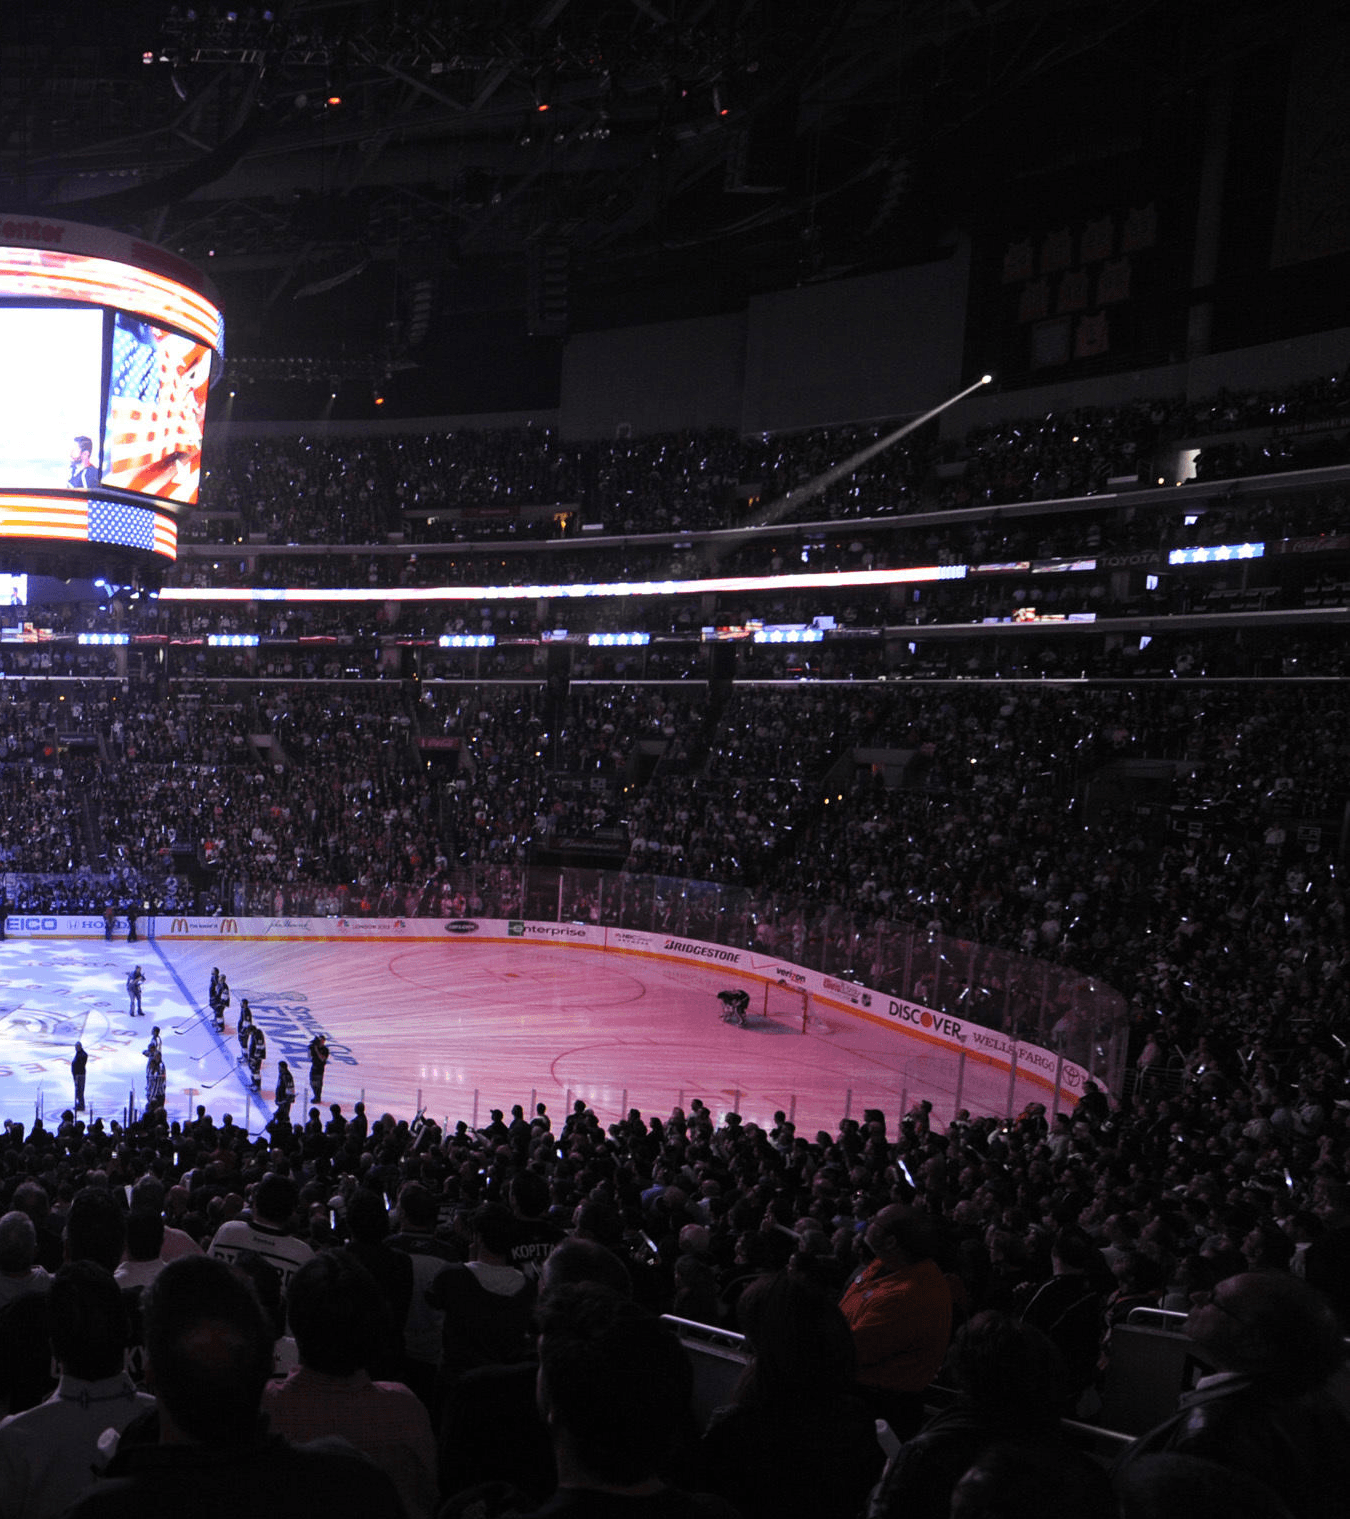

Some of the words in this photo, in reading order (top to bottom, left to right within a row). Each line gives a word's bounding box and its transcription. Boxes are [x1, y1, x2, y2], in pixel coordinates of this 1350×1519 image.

[1098, 552, 1160, 567] TOYOTA
[513, 922, 587, 937] enterprise
[663, 939, 742, 963] BRIDGESTONE
[776, 967, 806, 984] verizon
[889, 1001, 962, 1040] DISCOVER
[973, 1032, 1016, 1055] WELLS
[1019, 1048, 1056, 1072] FARGO
[510, 1242, 555, 1262] KOPITA
